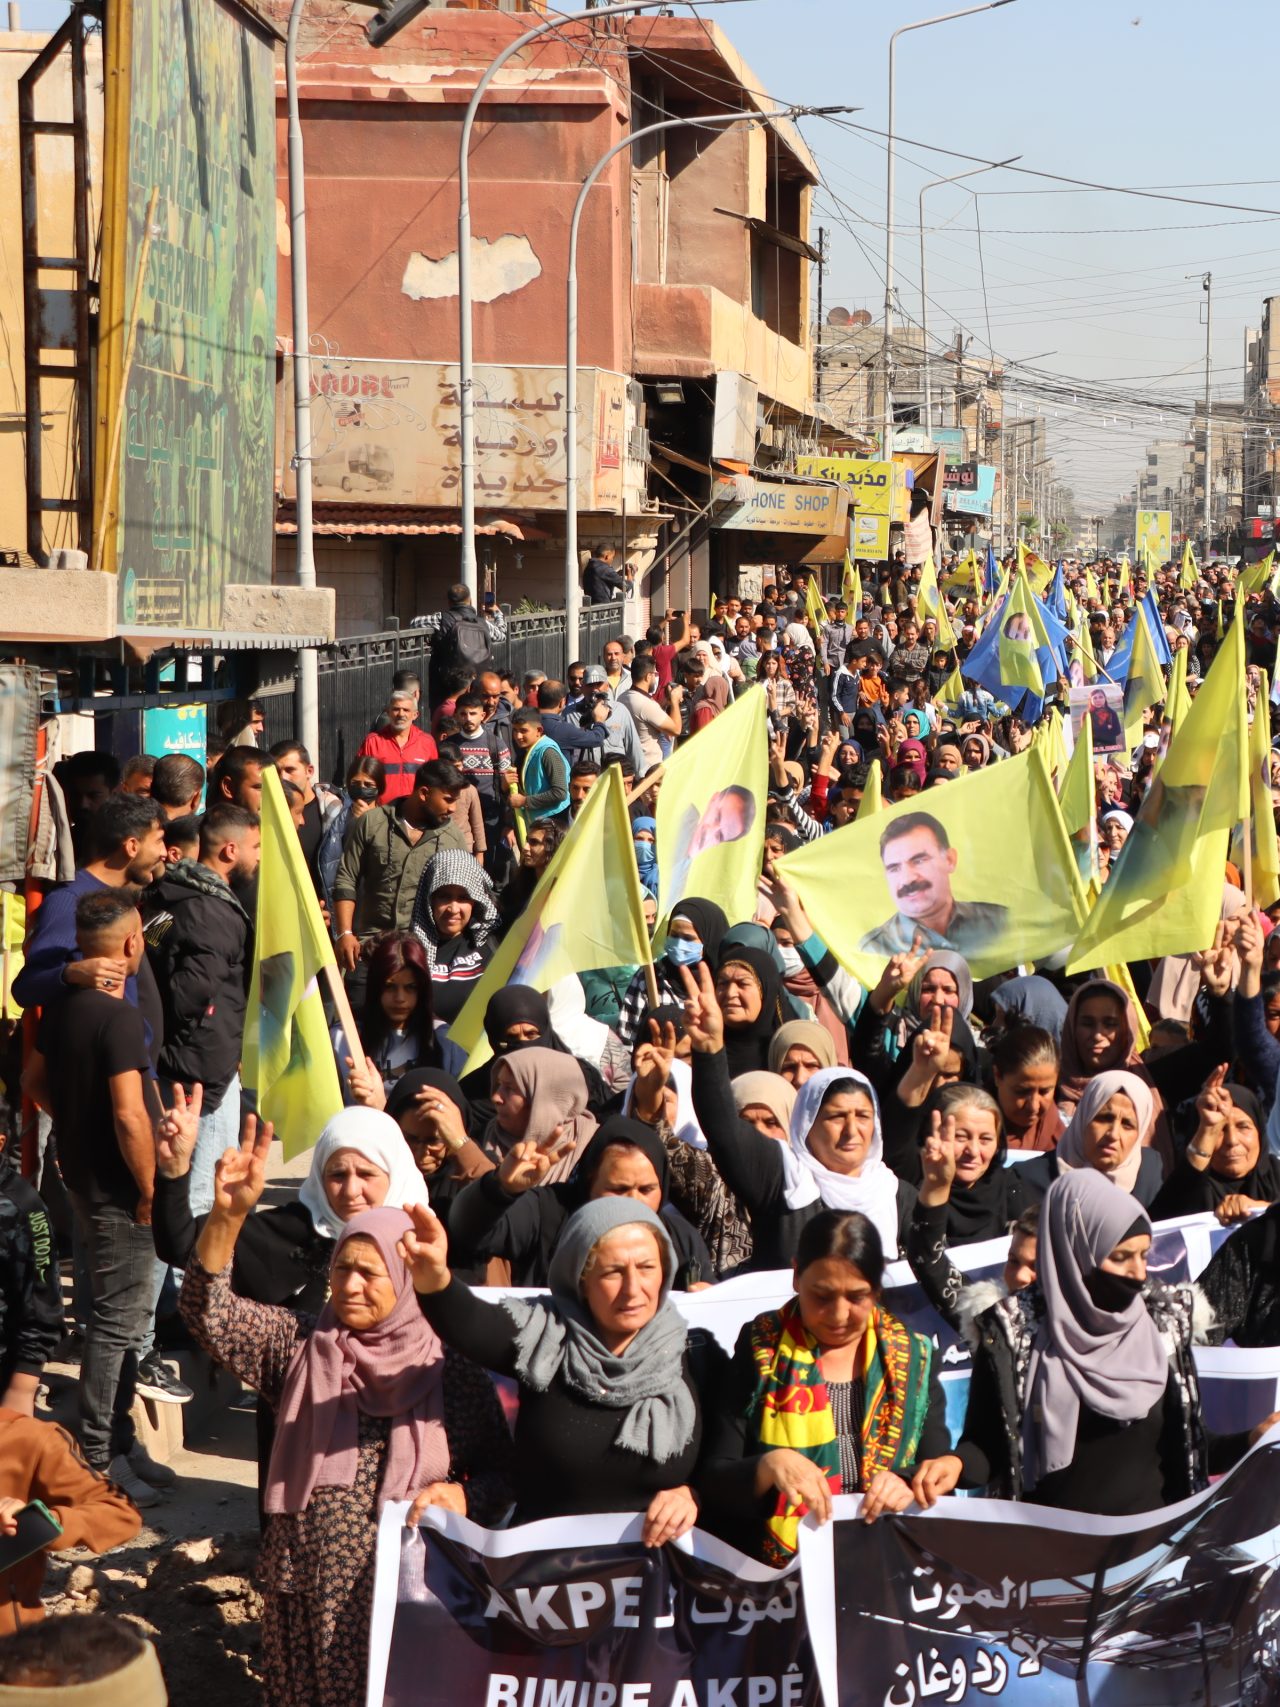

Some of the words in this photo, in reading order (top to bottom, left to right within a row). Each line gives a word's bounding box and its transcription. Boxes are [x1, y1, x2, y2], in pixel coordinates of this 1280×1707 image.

[751, 492, 786, 510] HONE
[795, 494, 830, 512] SHOP
[28, 1211, 50, 1237] JUST
[33, 1237, 51, 1255] DO
[909, 1566, 1028, 1620] الموت
[690, 1580, 799, 1636] لموت
